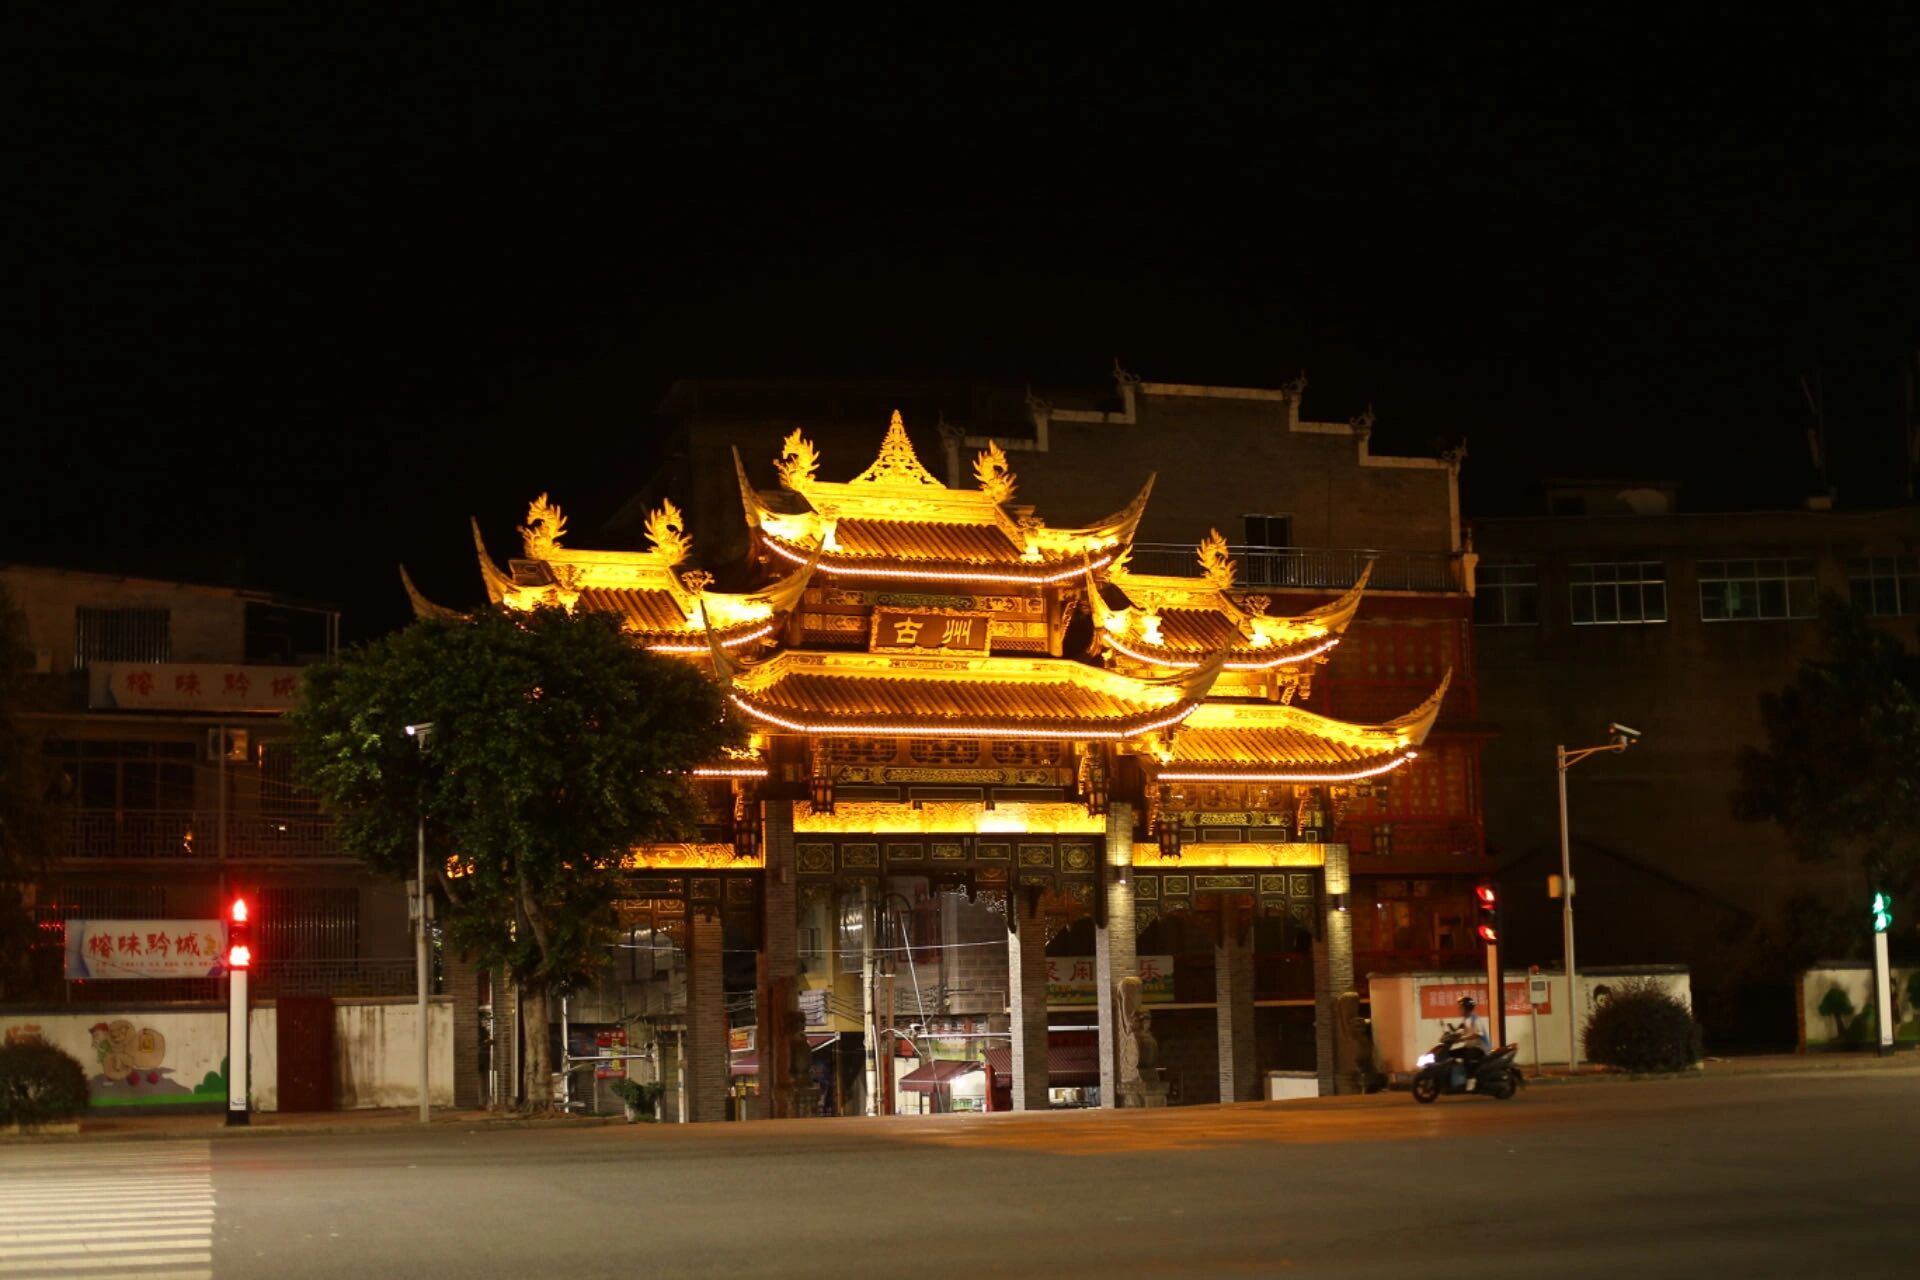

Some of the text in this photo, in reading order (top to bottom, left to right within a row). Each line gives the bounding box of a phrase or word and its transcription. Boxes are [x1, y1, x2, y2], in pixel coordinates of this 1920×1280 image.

[894, 616, 973, 646] 古州
[89, 930, 201, 959] 榕味黔城
